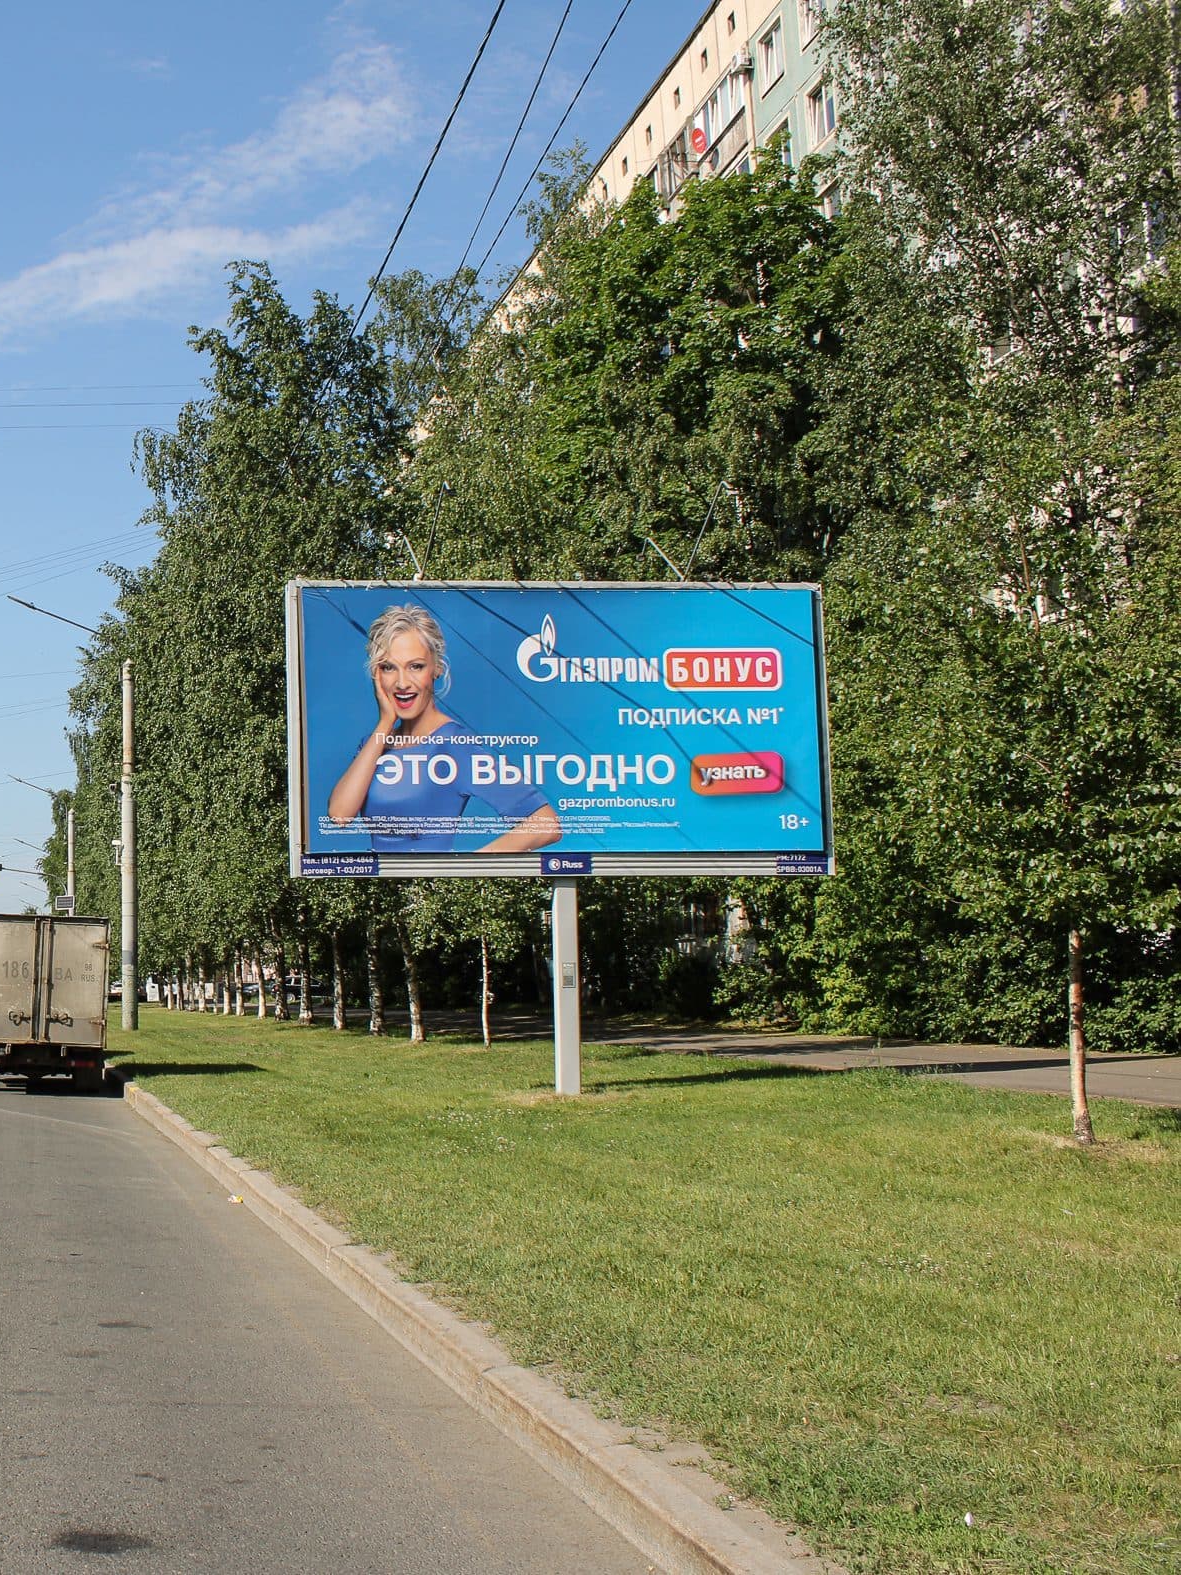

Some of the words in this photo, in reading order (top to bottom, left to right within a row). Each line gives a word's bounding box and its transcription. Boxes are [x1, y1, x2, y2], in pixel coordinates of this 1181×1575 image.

[560, 657, 659, 683] ГАЗПРОМ
[671, 656, 773, 683] БОНУС
[618, 708, 741, 729] ПОДПИСКА
[375, 732, 539, 748] Подписка-конструктор
[375, 754, 458, 785] ЭТО
[471, 754, 676, 792] ВЫГОДНО
[700, 764, 767, 786] узнать
[558, 796, 676, 811] gazprombonus.ru
[778, 813, 810, 830] 18+
[321, 856, 339, 865] (812)
[562, 860, 584, 869] Russ
[302, 867, 335, 875] договор:
[3, 960, 30, 979] 186
[80, 974, 96, 983] RUS
